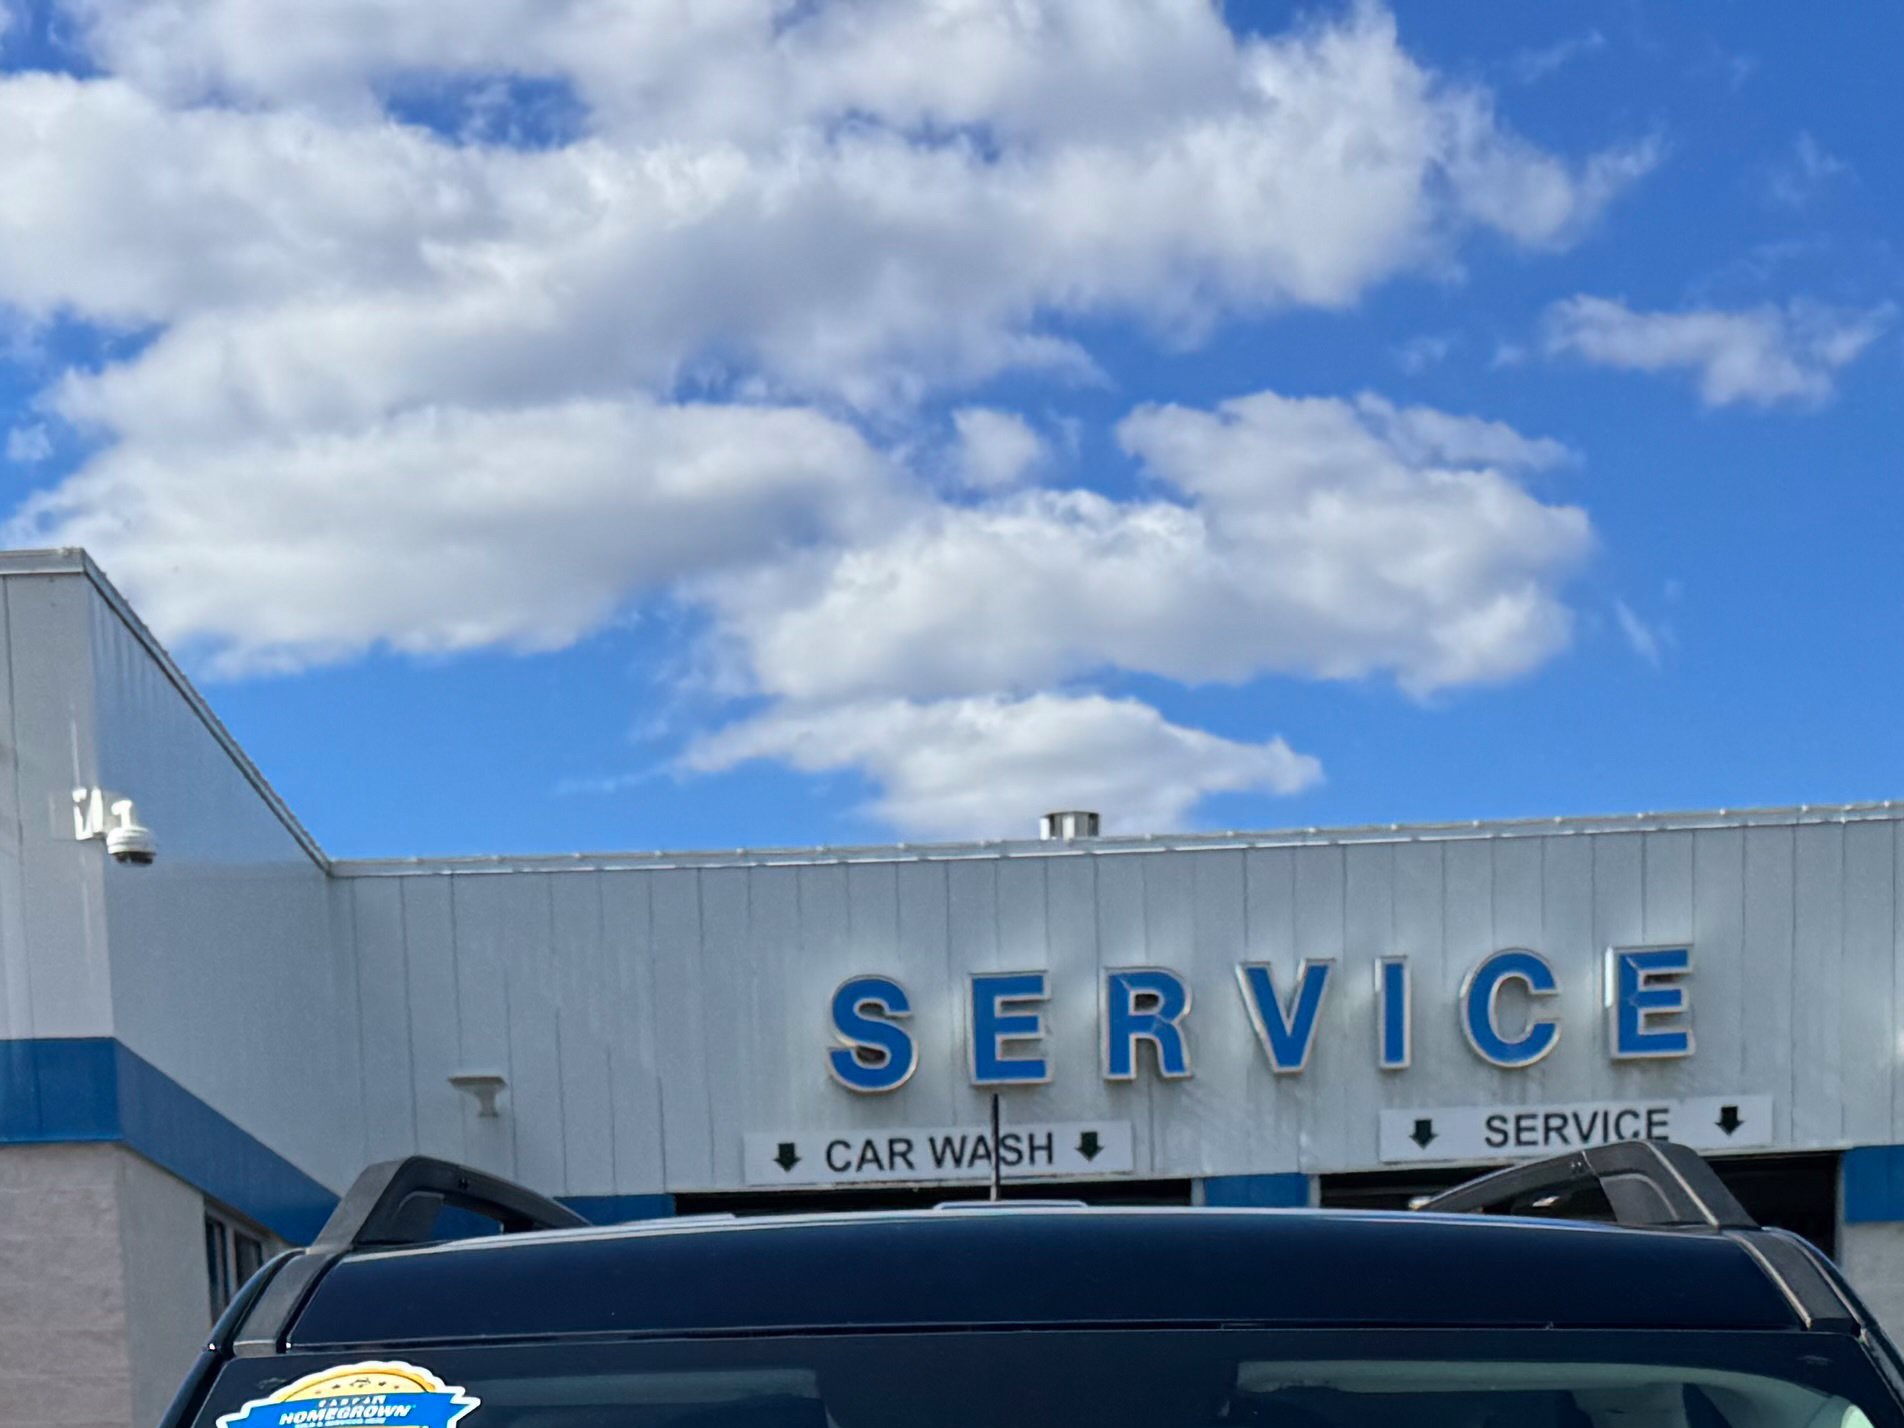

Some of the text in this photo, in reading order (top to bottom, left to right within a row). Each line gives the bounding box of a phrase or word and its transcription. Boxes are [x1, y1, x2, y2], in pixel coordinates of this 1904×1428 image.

[826, 942, 1696, 1095] SERVICE
[1484, 1108, 1670, 1148] SERVICE
[826, 1131, 1053, 1173] CAR WASH
[279, 1405, 411, 1425] HOMEGROWN
